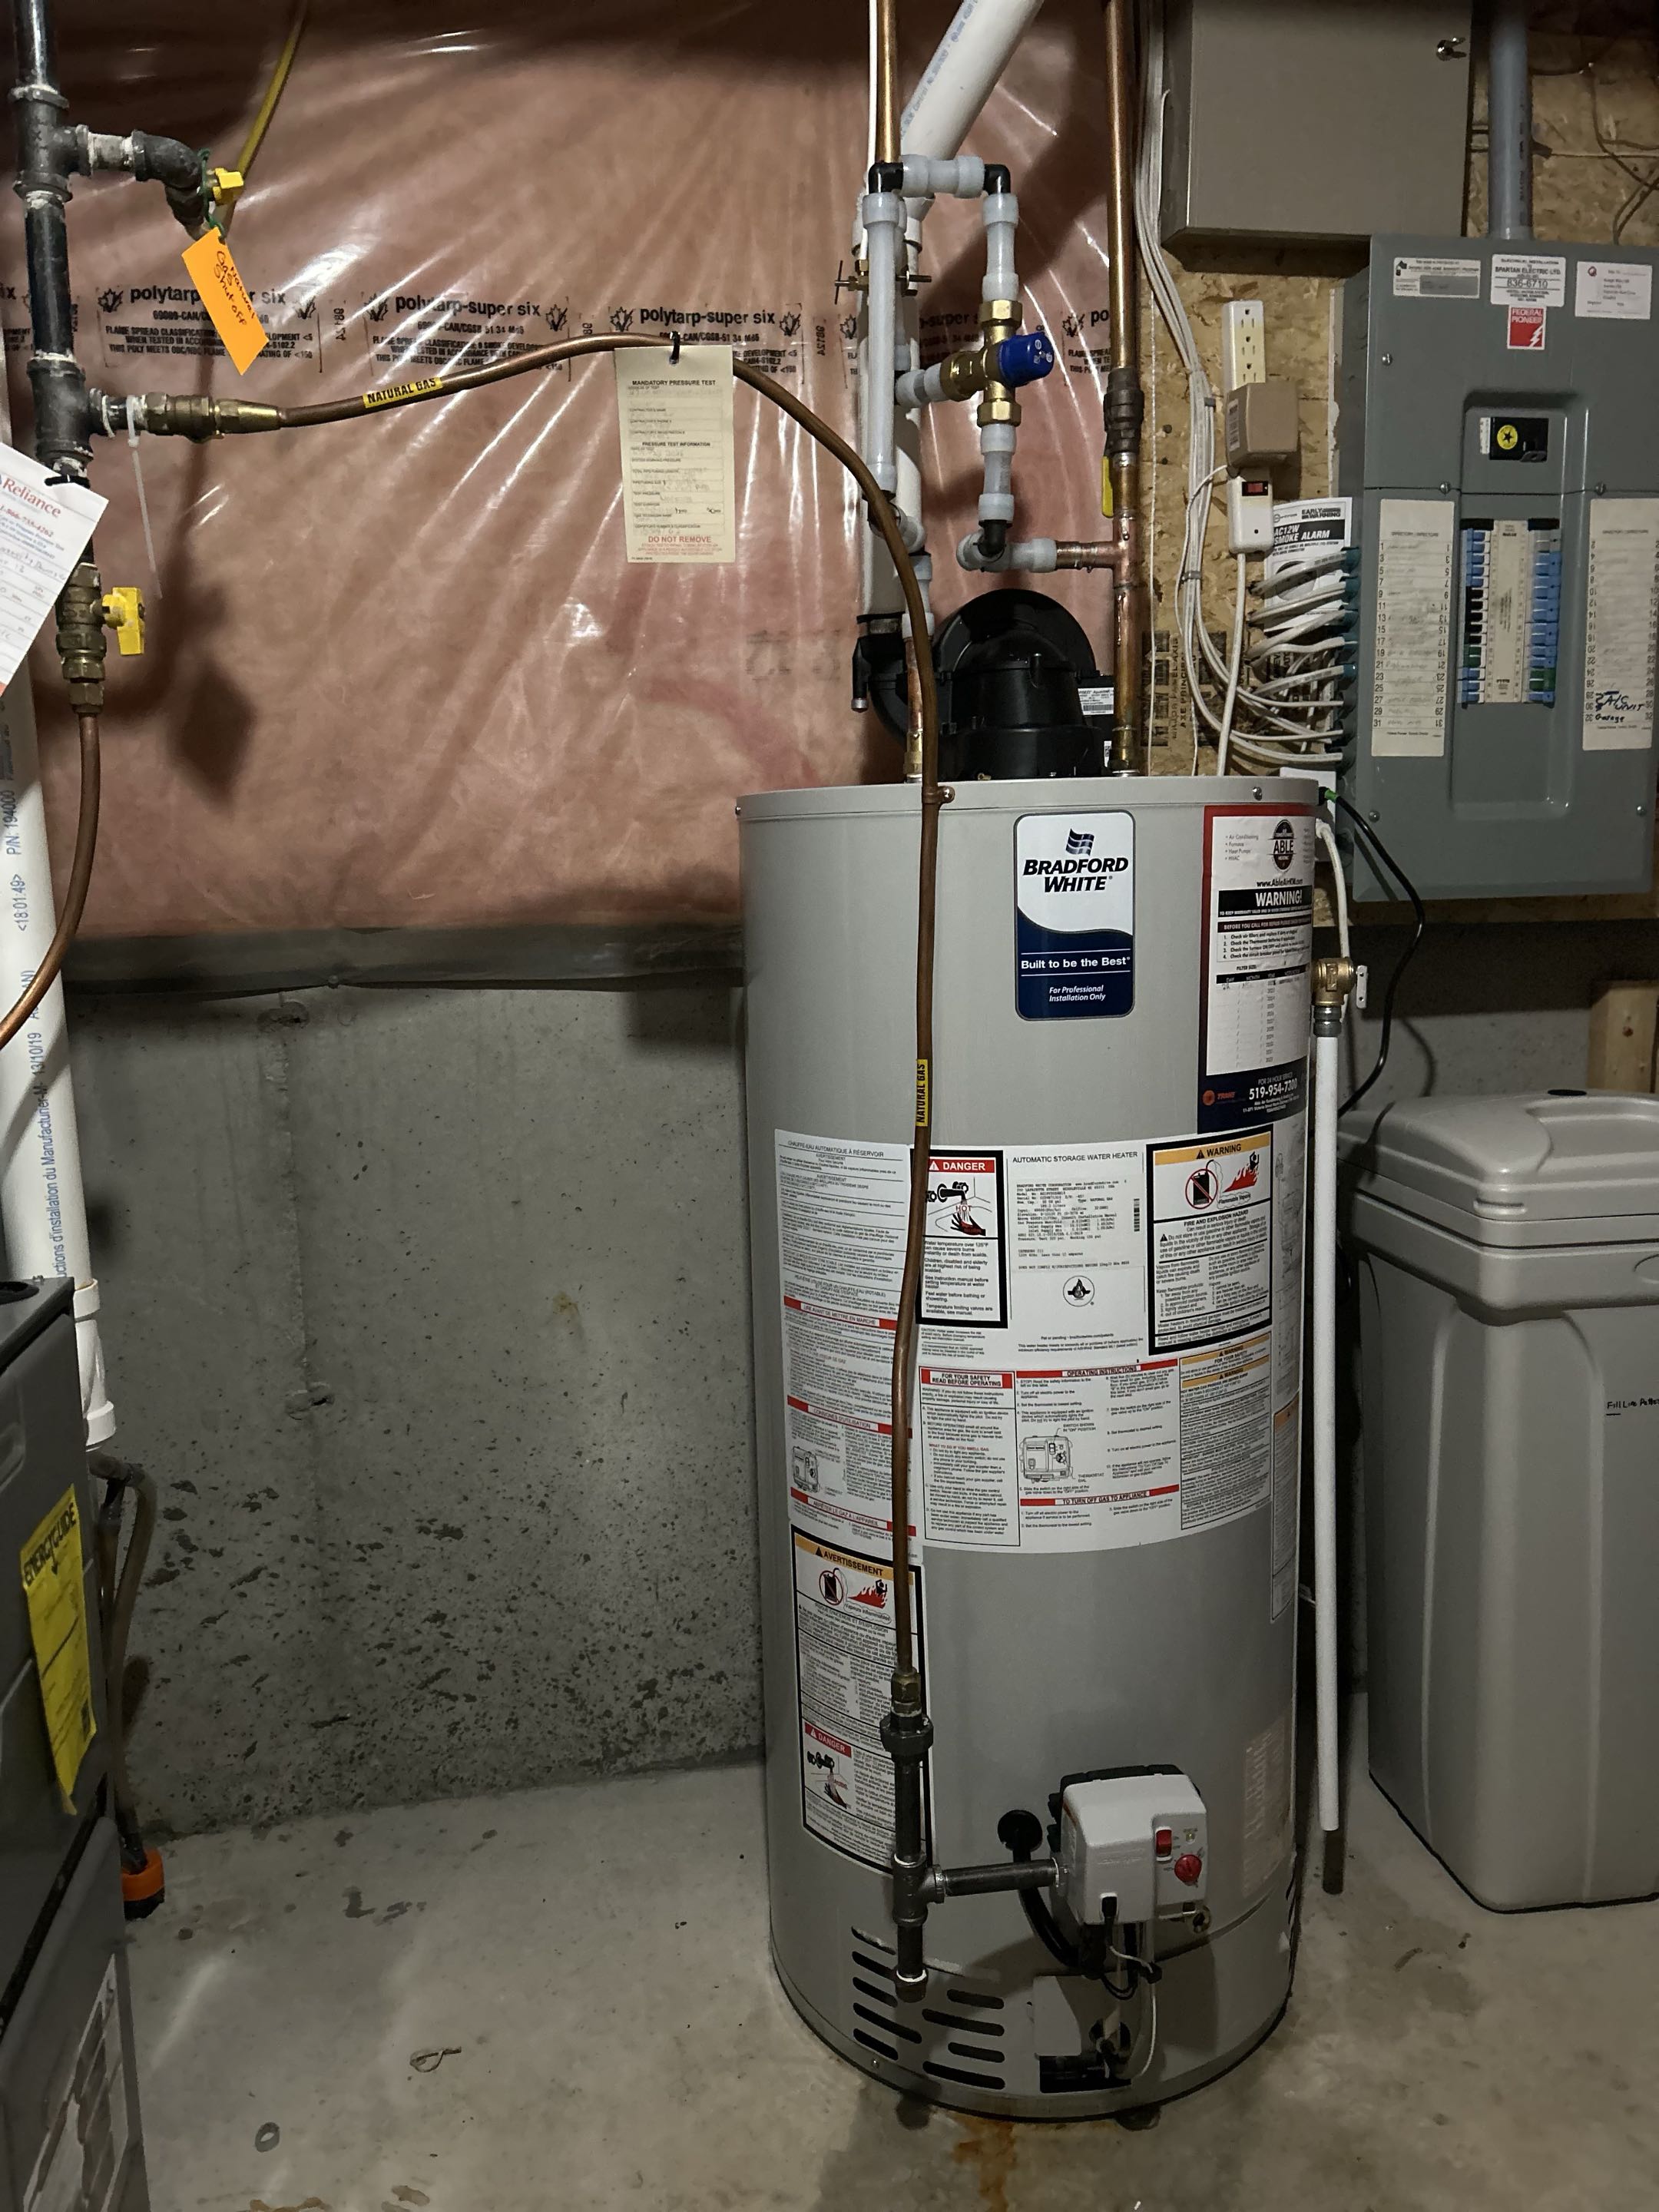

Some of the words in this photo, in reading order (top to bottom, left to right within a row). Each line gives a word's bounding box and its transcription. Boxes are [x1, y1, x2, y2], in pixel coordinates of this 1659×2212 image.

[216, 250, 233, 286] Gas
[214, 264, 234, 301] Shut
[1507, 278, 1548, 289] 836-6710
[262, 290, 286, 305] six
[517, 301, 541, 316] six
[640, 306, 749, 327] polytarp-super
[753, 310, 776, 325] six
[147, 346, 170, 354] MEETS
[366, 382, 414, 405] NATURAL
[416, 377, 437, 392] GAS
[2, 477, 61, 518] Reliance
[1274, 524, 1300, 537] AC12W
[1274, 532, 1300, 545] SMOKE
[1302, 530, 1330, 541] ALARM
[1379, 554, 1385, 562] 3
[1379, 566, 1384, 575] 5
[1377, 637, 1386, 645] 17
[1376, 672, 1384, 680] 23
[1375, 684, 1383, 692] 25
[1374, 696, 1382, 704] 27
[1273, 839, 1294, 854] ABLE
[1022, 856, 1129, 876] BRADFORD
[1043, 876, 1108, 893] WHITE
[1255, 889, 1303, 907] WARNING!
[1021, 959, 1046, 969] Built
[1048, 959, 1060, 969] to
[1062, 958, 1078, 968] be
[1080, 957, 1098, 967] the
[1101, 956, 1127, 967] Best
[1049, 986, 1061, 995] For
[1061, 985, 1104, 994] Professional
[1049, 993, 1088, 1002] Installation
[1089, 993, 1106, 1002] Only
[916, 1063, 926, 1083] GAS
[916, 1083, 926, 1123] NATURAL
[815, 1144, 847, 1154] AUTOMATIQUE
[1206, 1143, 1242, 1157] WARNING
[1053, 1154, 1086, 1162] STORAGE
[1112, 1151, 1137, 1160] HEATER
[942, 1161, 985, 1171] DANGER
[42, 1167, 56, 1181] du
[44, 1182, 64, 1242] d'installation
[955, 1204, 972, 1213] HOT
[1207, 1214, 1232, 1223] EXPLOSION
[1099, 1366, 1137, 1376] INSTRUCTIONS
[1607, 1400, 1621, 1409] Fill
[1118, 1491, 1147, 1502] APPLIANCE
[823, 1550, 883, 1576] AVERTISSEMENT
[817, 1731, 846, 1753] DANGER
